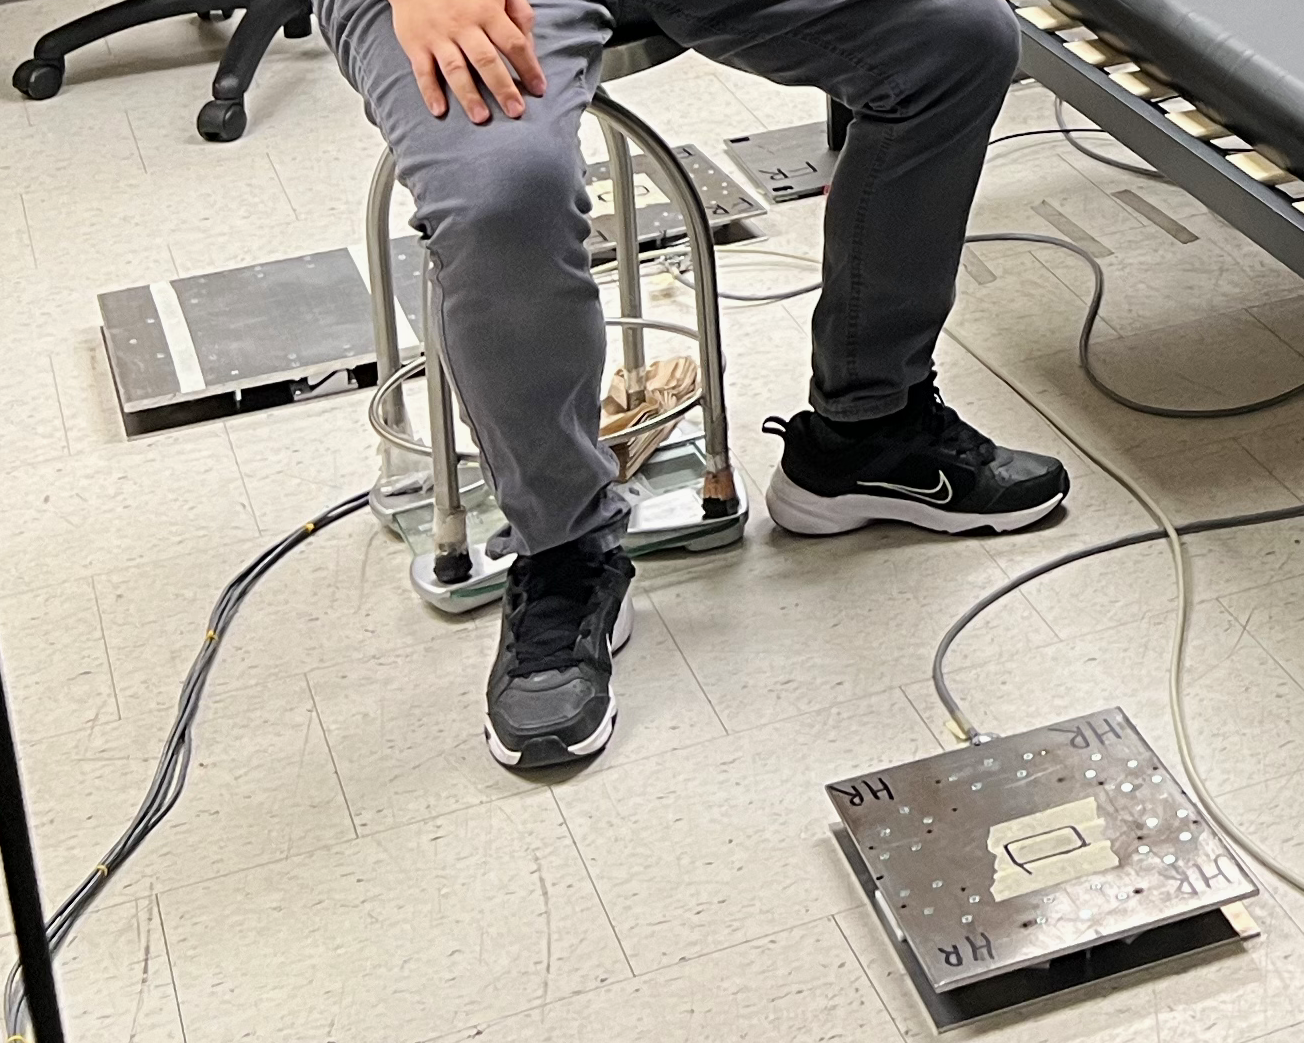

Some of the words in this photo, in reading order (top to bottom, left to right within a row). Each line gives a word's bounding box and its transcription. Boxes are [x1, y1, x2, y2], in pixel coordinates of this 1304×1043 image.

[759, 161, 818, 181] FR
[1047, 717, 1123, 750] HR
[825, 777, 895, 808] HR
[937, 932, 996, 967] HR
